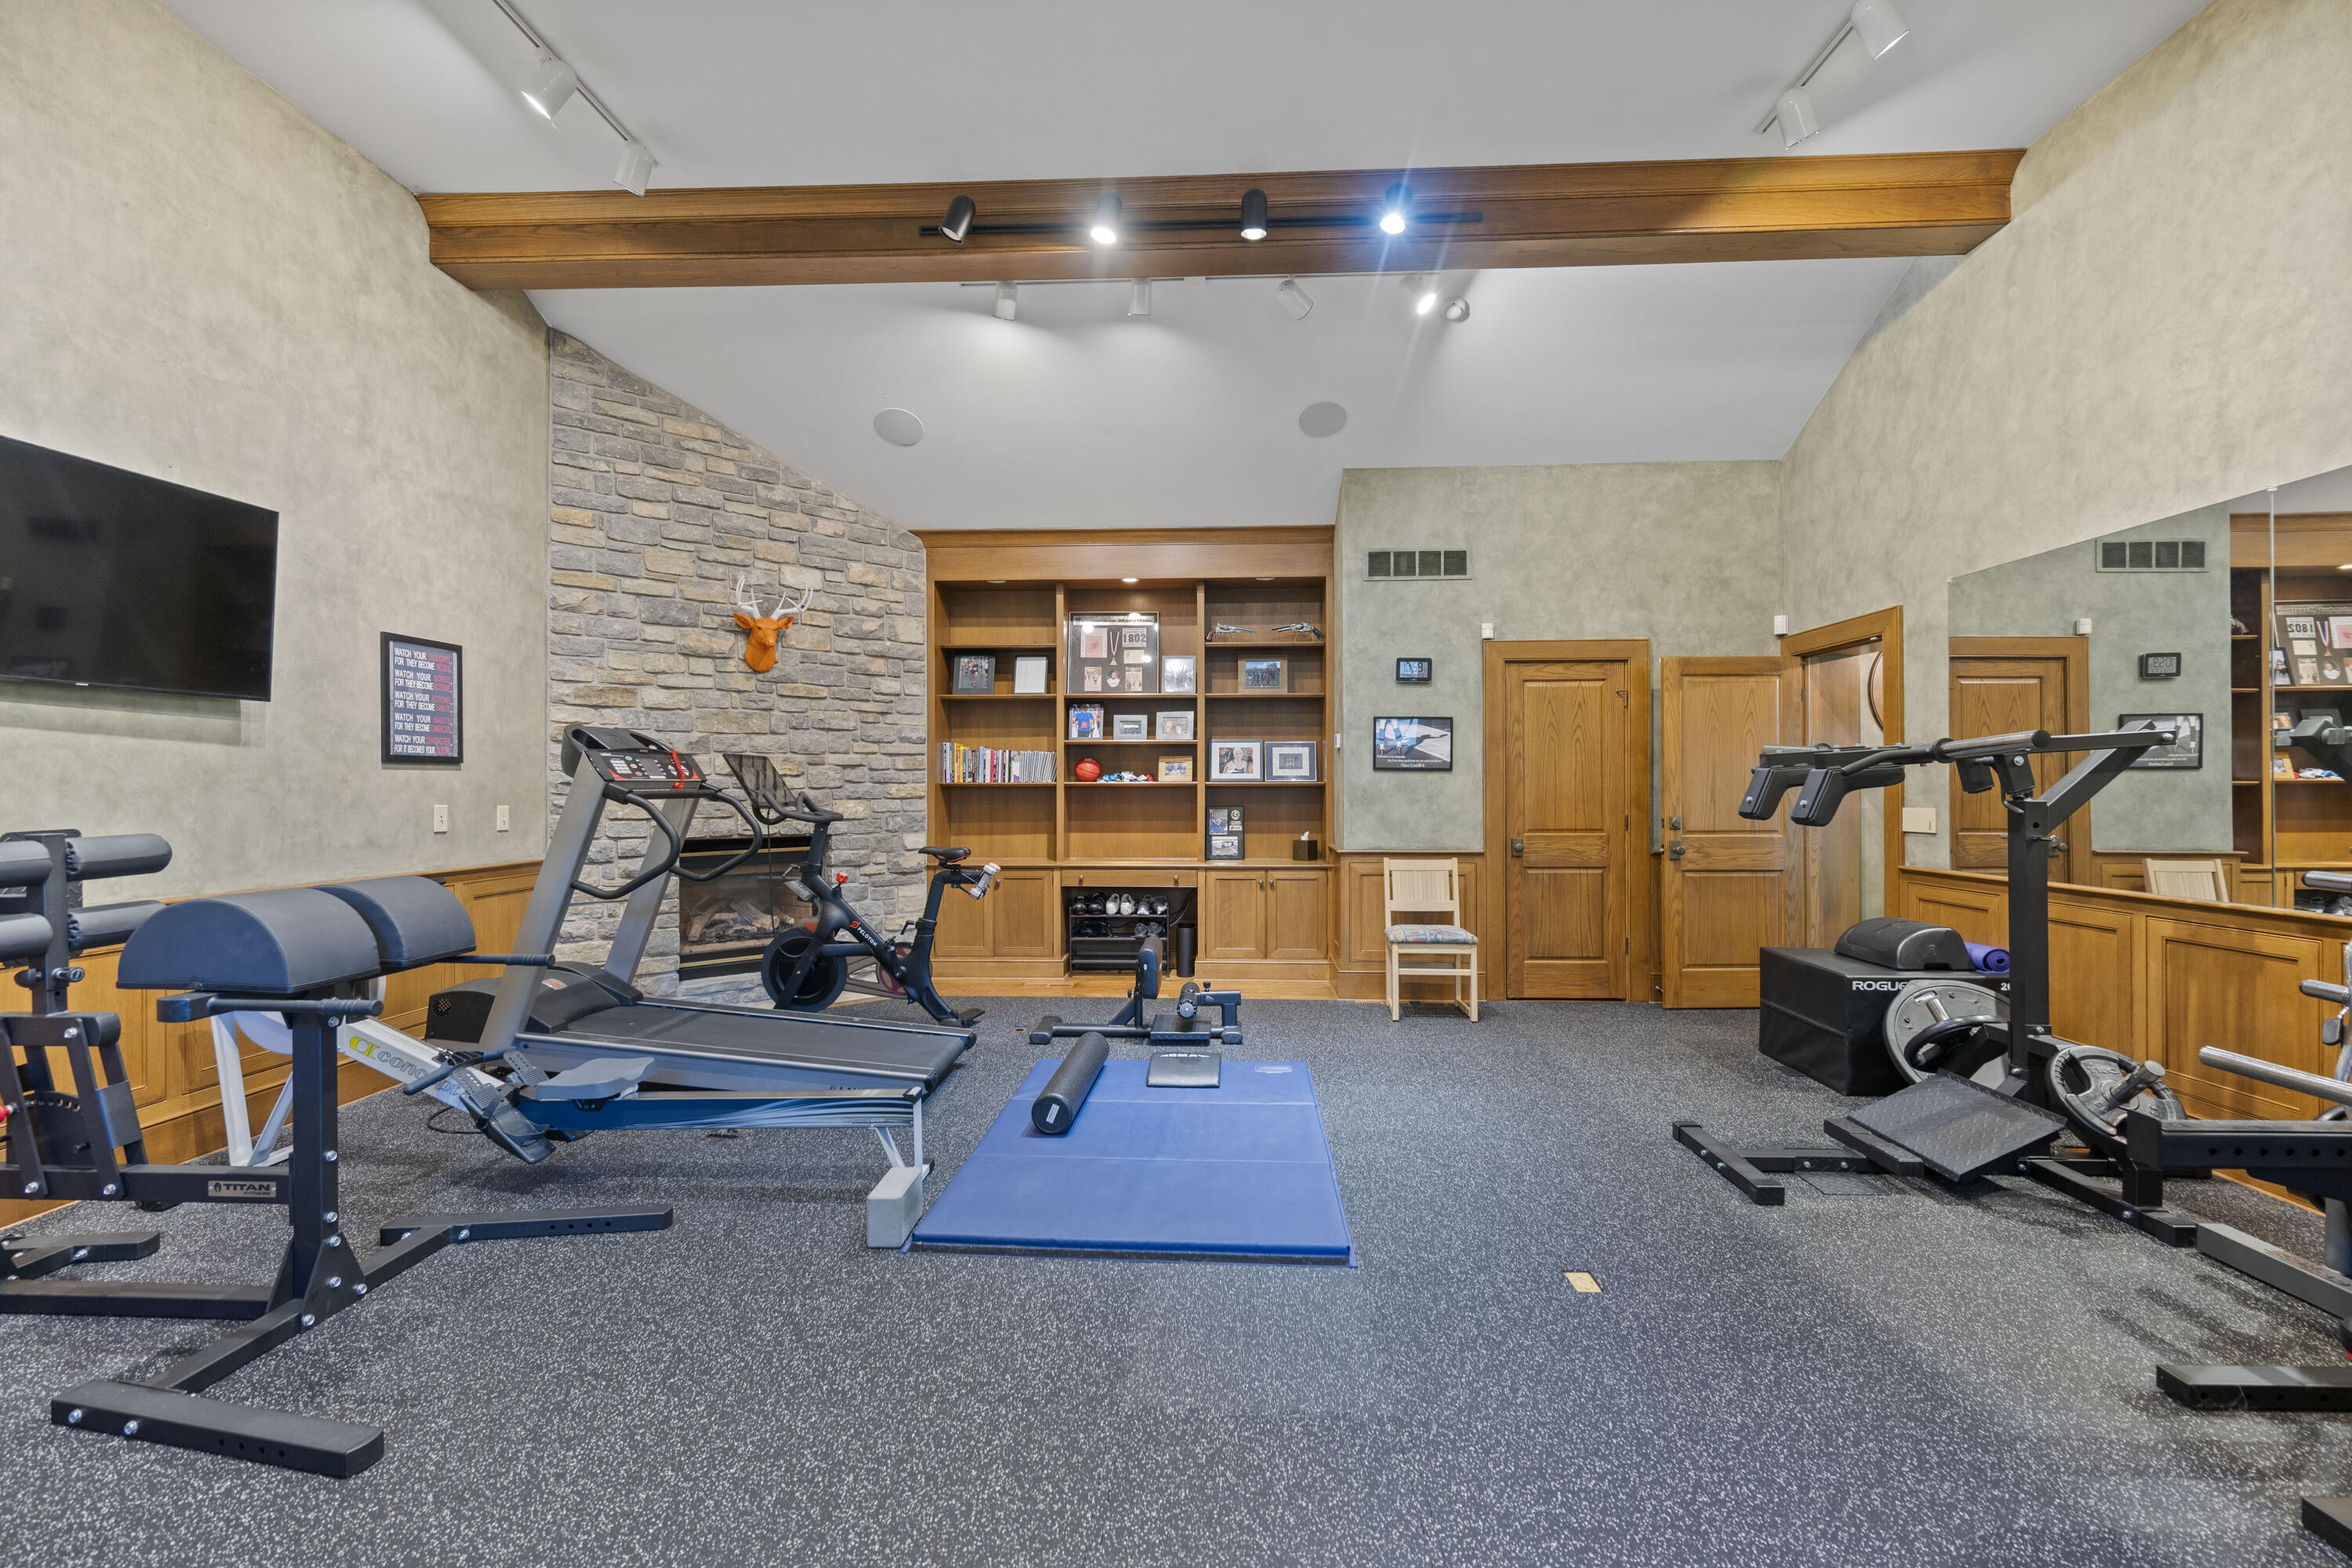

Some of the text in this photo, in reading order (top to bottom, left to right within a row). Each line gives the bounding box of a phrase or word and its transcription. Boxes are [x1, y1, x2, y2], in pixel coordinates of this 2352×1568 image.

[1123, 633, 1146, 643] 1802
[394, 647, 412, 658] WATCH
[413, 651, 426, 660] YOUR
[394, 656, 405, 666] FOR
[406, 659, 417, 668] THEY
[418, 660, 435, 670] BECOME
[394, 669, 414, 679] WATCH
[416, 672, 431, 681] YOUR
[394, 677, 405, 687] FOR
[405, 679, 416, 688] THEY
[416, 681, 434, 690] BECOME
[394, 690, 414, 700] WATCH
[415, 692, 430, 702] YOUR
[394, 699, 405, 708] FOR
[406, 701, 417, 710] THEY
[418, 702, 435, 711] BECOME
[394, 713, 414, 722] WATCH
[416, 714, 431, 724] YOUR
[394, 721, 404, 730] FOR
[404, 722, 415, 731] THEY
[415, 723, 430, 732] BECOME
[394, 734, 412, 743] WATCH
[412, 735, 426, 744] YOUR
[394, 744, 403, 753] FOR
[408, 745, 425, 753] BECOMES
[425, 746, 436, 754] YOUR
[857, 927, 877, 946] PELOTON
[377, 1051, 462, 1096] concpt
